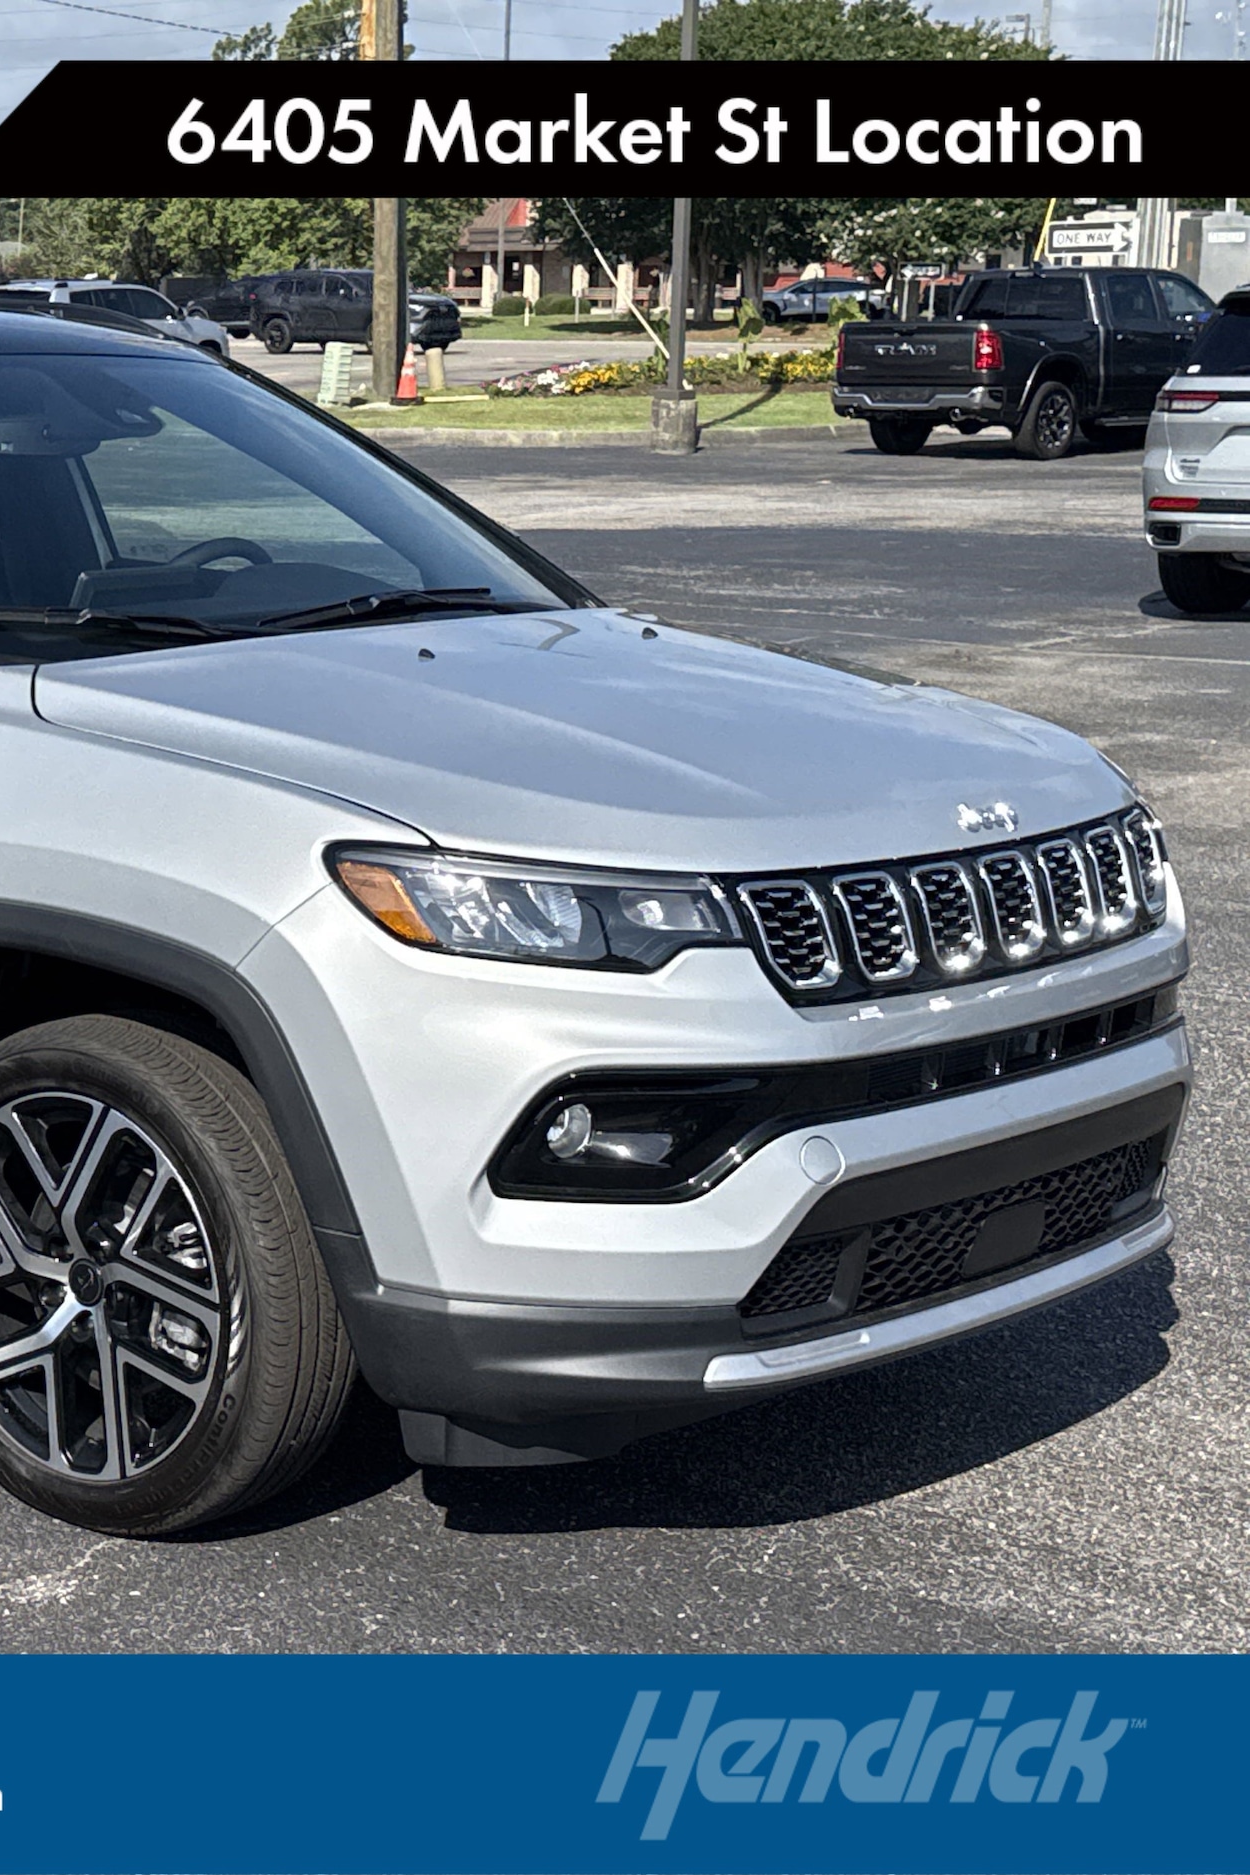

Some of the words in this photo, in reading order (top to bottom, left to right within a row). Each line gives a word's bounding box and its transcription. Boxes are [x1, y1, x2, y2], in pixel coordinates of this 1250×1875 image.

[1056, 232, 1081, 245] ONE
[1086, 231, 1112, 244] WAY
[874, 342, 938, 356] RAM
